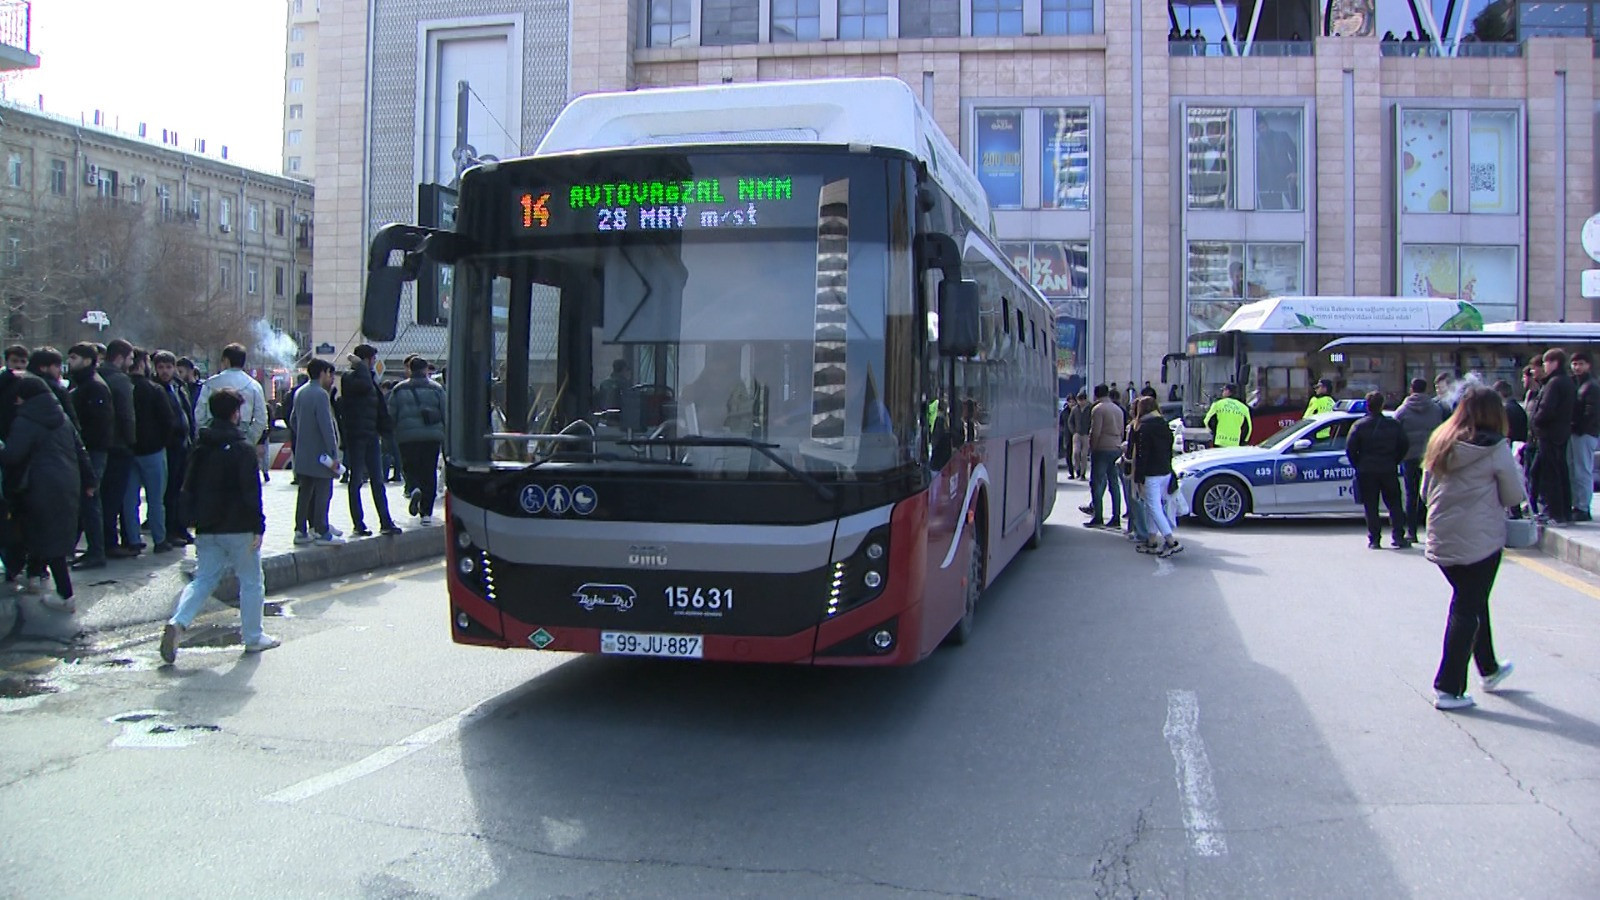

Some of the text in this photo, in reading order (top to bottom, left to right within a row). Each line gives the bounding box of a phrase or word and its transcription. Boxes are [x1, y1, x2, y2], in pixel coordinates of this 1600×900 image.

[738, 177, 792, 200] NMM
[598, 207, 628, 230] 28
[640, 205, 687, 229] MAY
[1302, 470, 1319, 480] YOL
[665, 586, 734, 609] 15631
[616, 634, 699, 655] 99-JU-887
